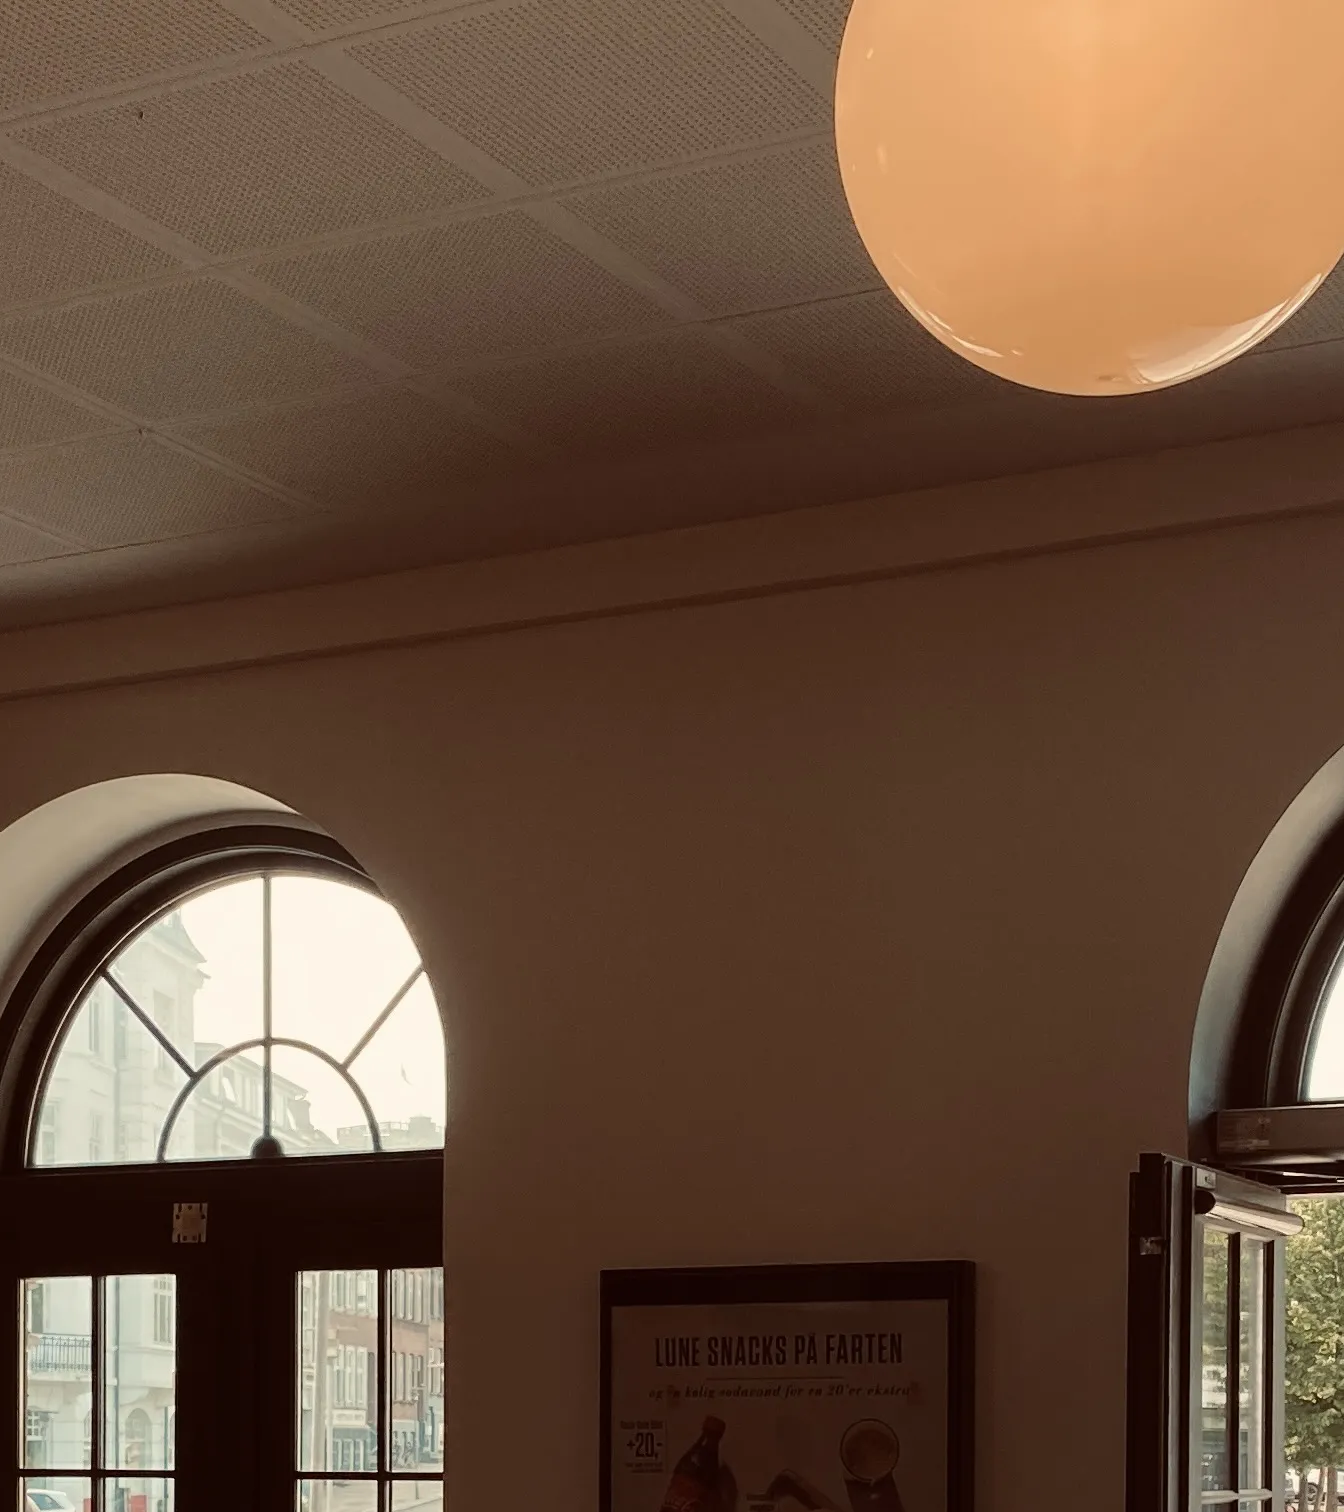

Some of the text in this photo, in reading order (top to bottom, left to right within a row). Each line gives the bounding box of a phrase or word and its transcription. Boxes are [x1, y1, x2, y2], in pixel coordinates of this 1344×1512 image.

[655, 1332, 903, 1367] LUNE SNACKS PÅ FARTEN
